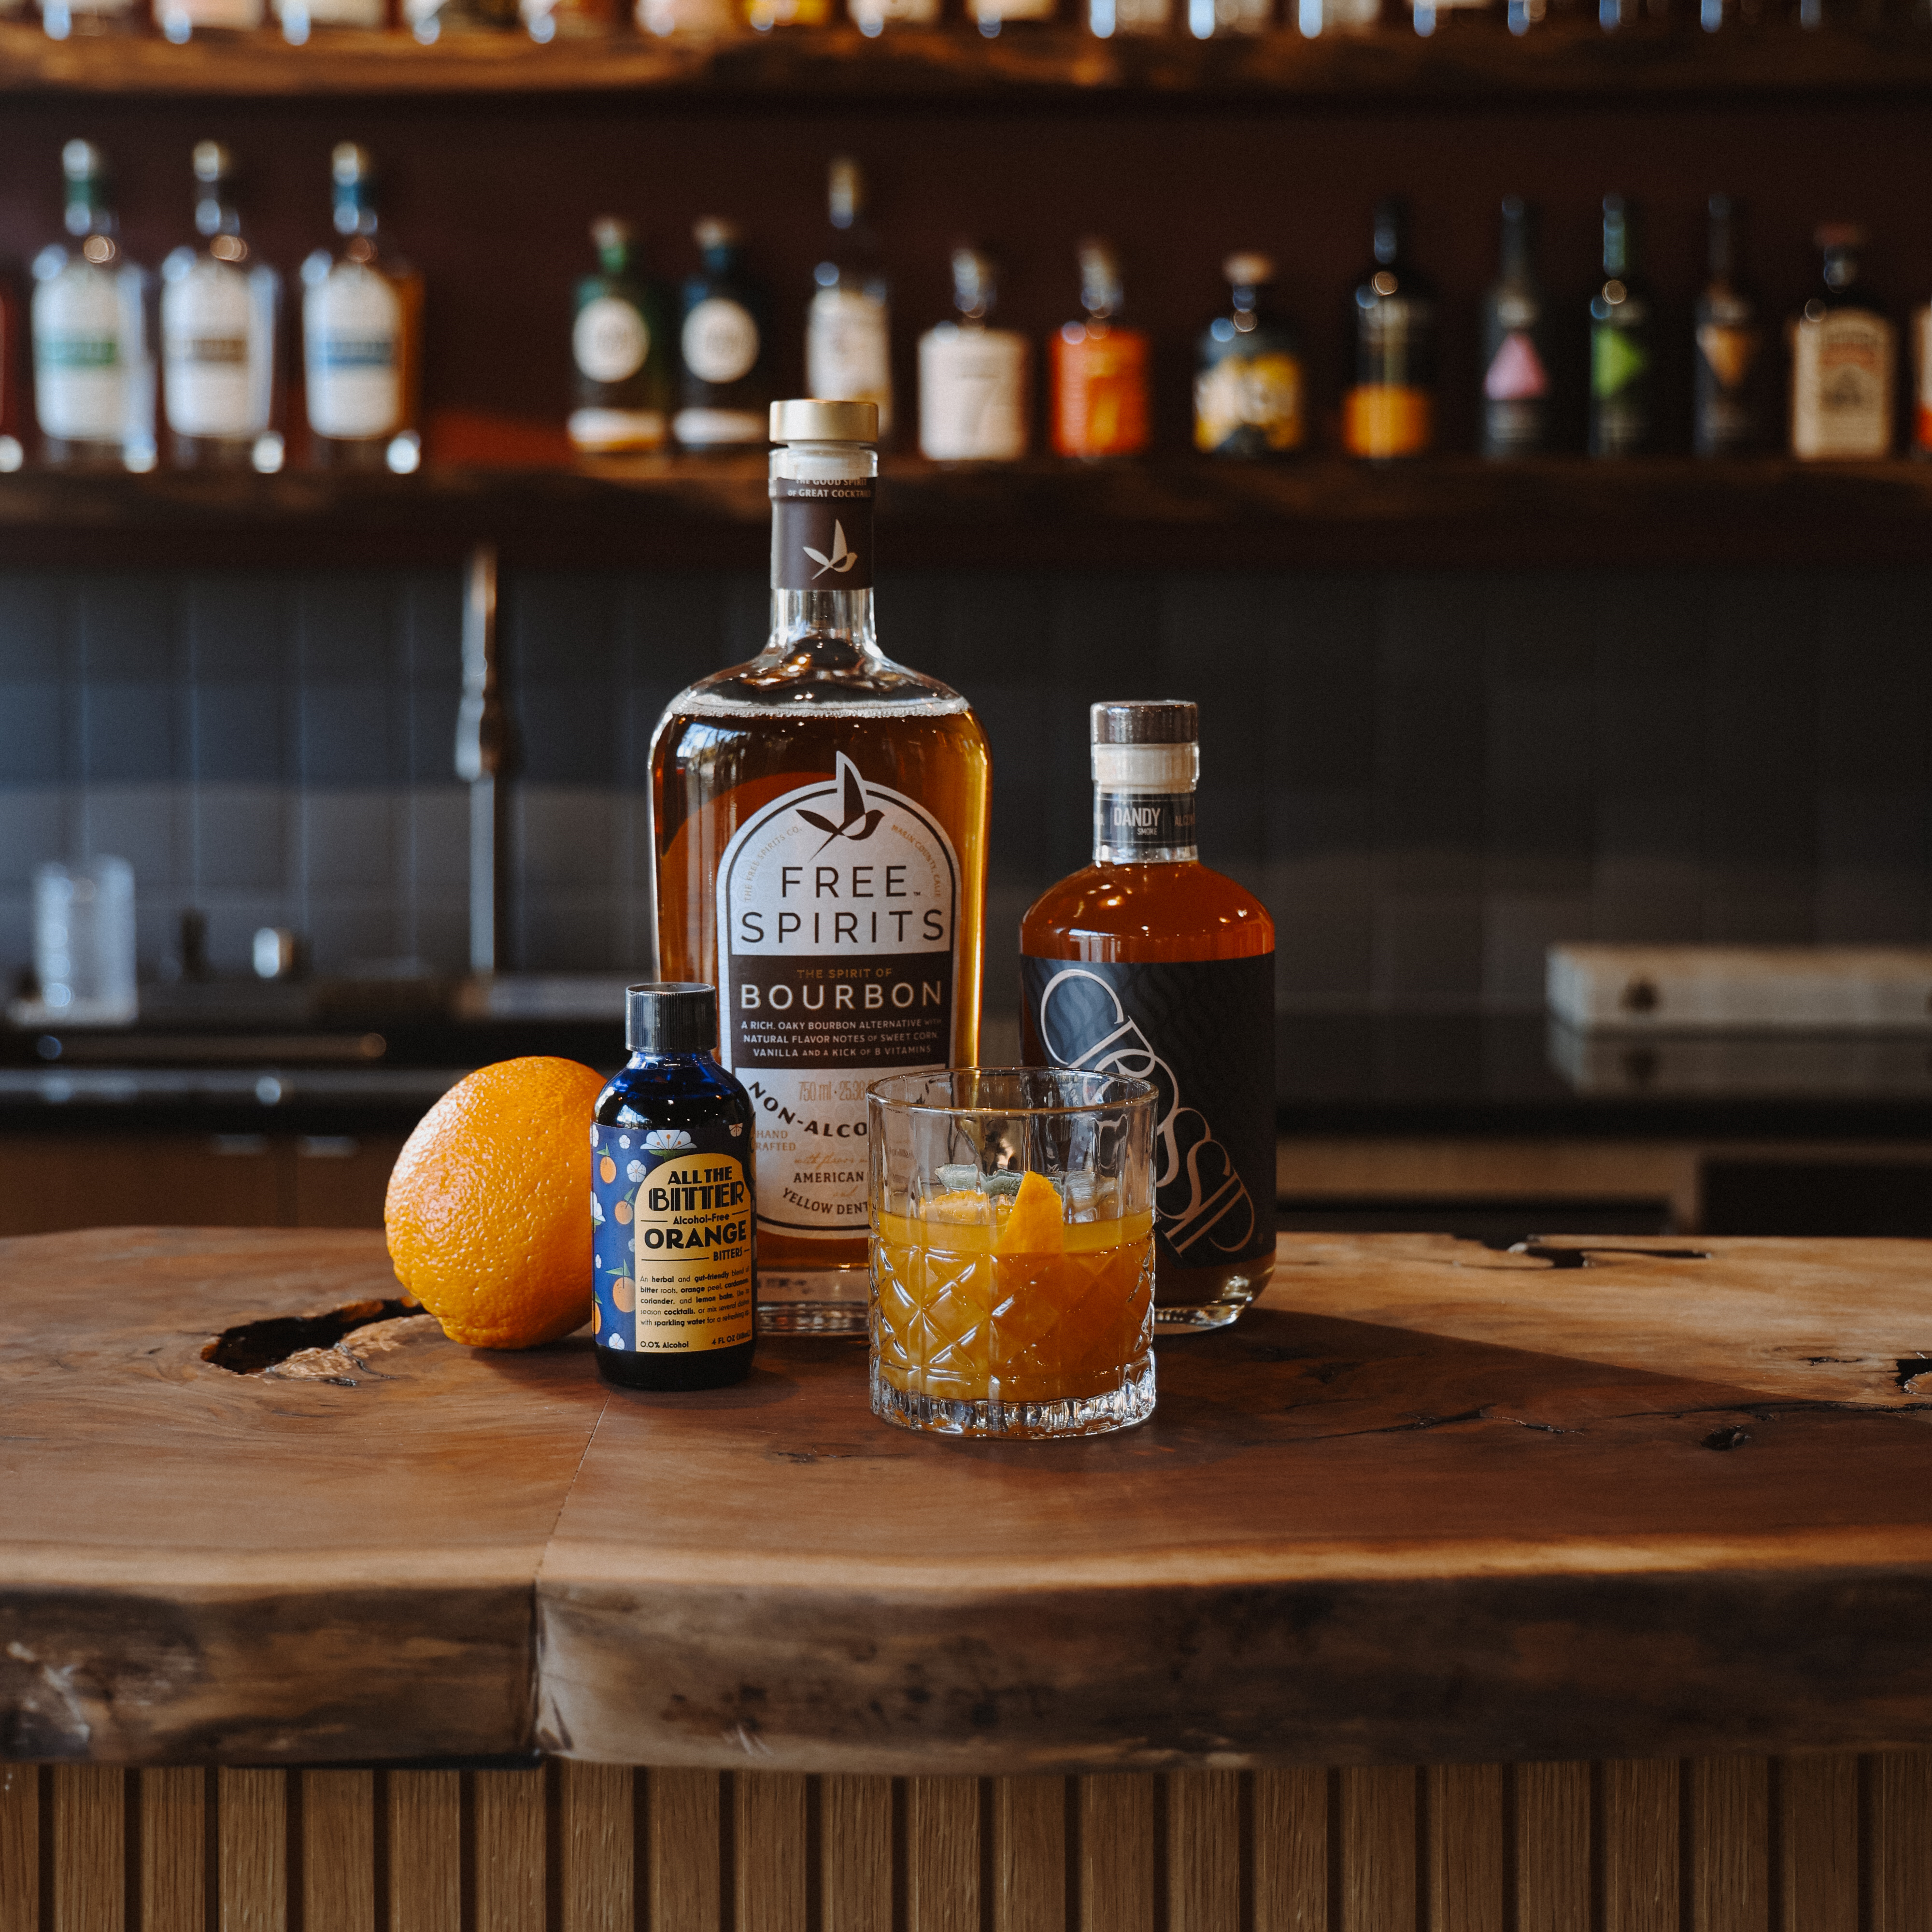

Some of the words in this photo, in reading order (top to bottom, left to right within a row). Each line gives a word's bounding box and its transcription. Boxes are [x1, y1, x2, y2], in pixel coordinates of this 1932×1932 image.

[798, 489, 828, 497] GREAT
[1114, 807, 1161, 826] DANDY
[1137, 827, 1157, 836] SMOKE
[746, 860, 759, 881] FREE
[757, 834, 785, 859] SPIRITS
[787, 826, 802, 836] CO.
[782, 866, 907, 898] FREE
[741, 909, 944, 943] SPIRITS
[797, 969, 822, 979] THE
[829, 968, 874, 979] SPIRIT
[876, 967, 892, 977] OF
[740, 980, 941, 1010] BOURBON
[741, 1021, 748, 1029] A
[809, 1022, 856, 1030] BOURBON
[859, 1019, 922, 1029] ALTERNATIVE
[743, 1035, 789, 1043] NATURAL
[792, 1035, 829, 1044] FLAVOR
[833, 1035, 865, 1043] NOTES
[881, 1033, 911, 1042] SWEET
[753, 1048, 798, 1057] VANILLA
[832, 1048, 856, 1057] KICK
[875, 1048, 881, 1056] B
[884, 1045, 931, 1055] VITAMINS
[798, 1081, 817, 1101] 750
[819, 1081, 832, 1101] ml
[756, 1130, 788, 1139] HAND
[755, 1142, 796, 1151] RAFTED
[668, 1170, 702, 1185] ALL
[704, 1166, 732, 1183] THE
[794, 1172, 864, 1183] AMERICAN
[649, 1180, 744, 1211] BITTER
[782, 1187, 833, 1214] YELLOW
[837, 1201, 868, 1215] DENT
[673, 1213, 730, 1225] Alcohol-Free
[644, 1220, 747, 1249] ORANGE
[713, 1247, 743, 1262] BITTERS
[694, 1271, 729, 1283] gut-friendly
[732, 1267, 744, 1277] blend
[719, 1301, 737, 1311] several
[654, 1319, 685, 1327] sparkling
[718, 1336, 725, 1345] FL
[726, 1334, 736, 1342] OZ
